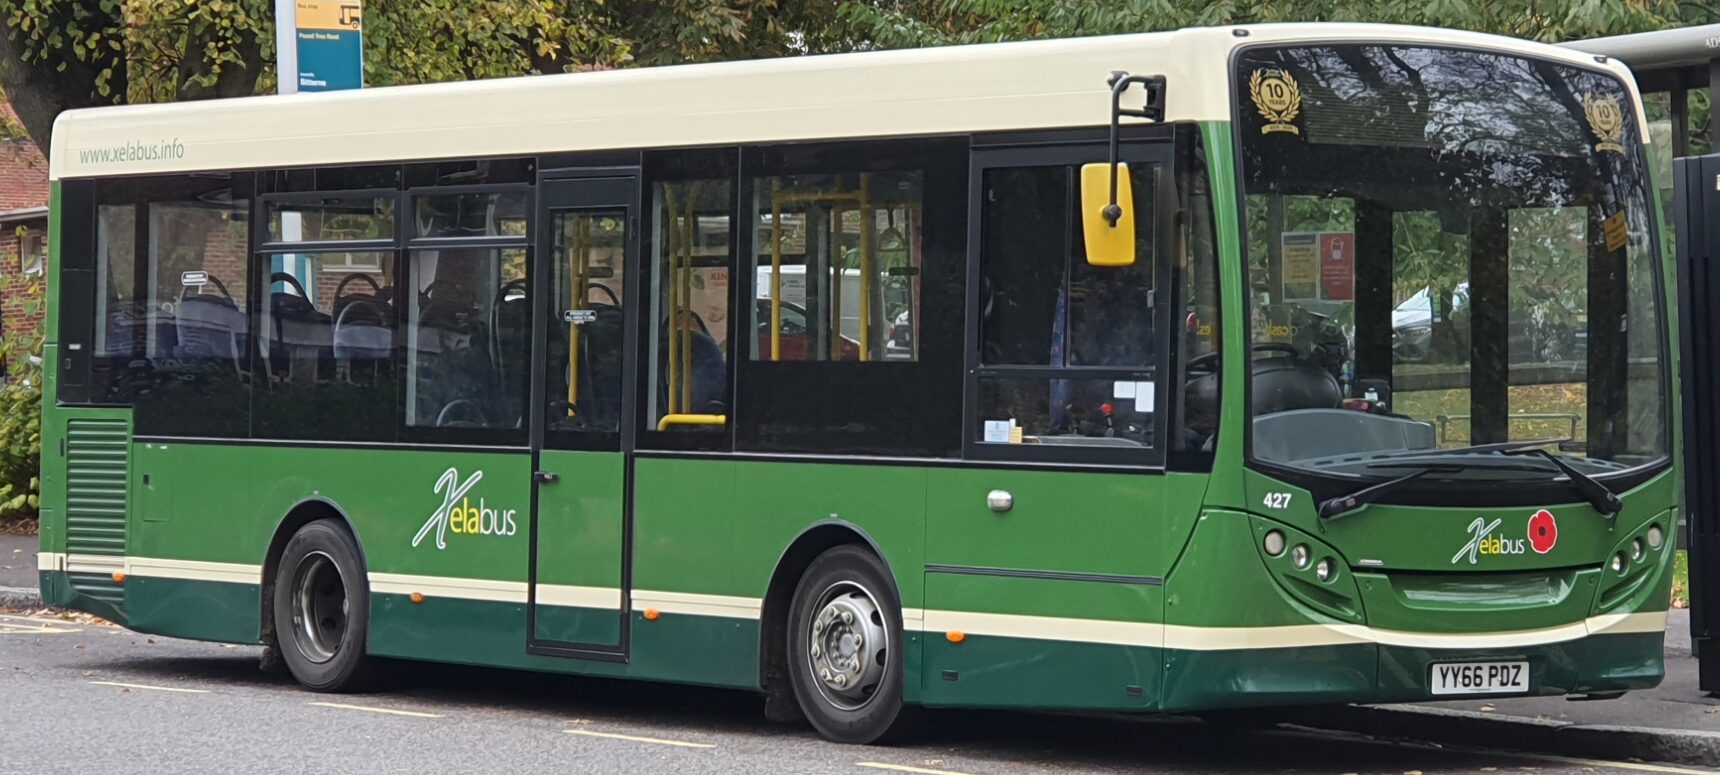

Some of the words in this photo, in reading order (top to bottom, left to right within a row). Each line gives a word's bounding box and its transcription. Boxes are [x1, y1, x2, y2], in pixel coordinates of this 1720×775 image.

[1705, 36, 1720, 48] AD
[1265, 82, 1284, 98] 10
[1596, 104, 1610, 119] 10
[79, 137, 184, 164] www.xelabus.info
[411, 467, 517, 550] Xelabus
[1263, 491, 1292, 509] 427
[1451, 517, 1525, 564] Xelabus
[1439, 665, 1483, 689] YY66
[1488, 664, 1522, 687] PDZ
